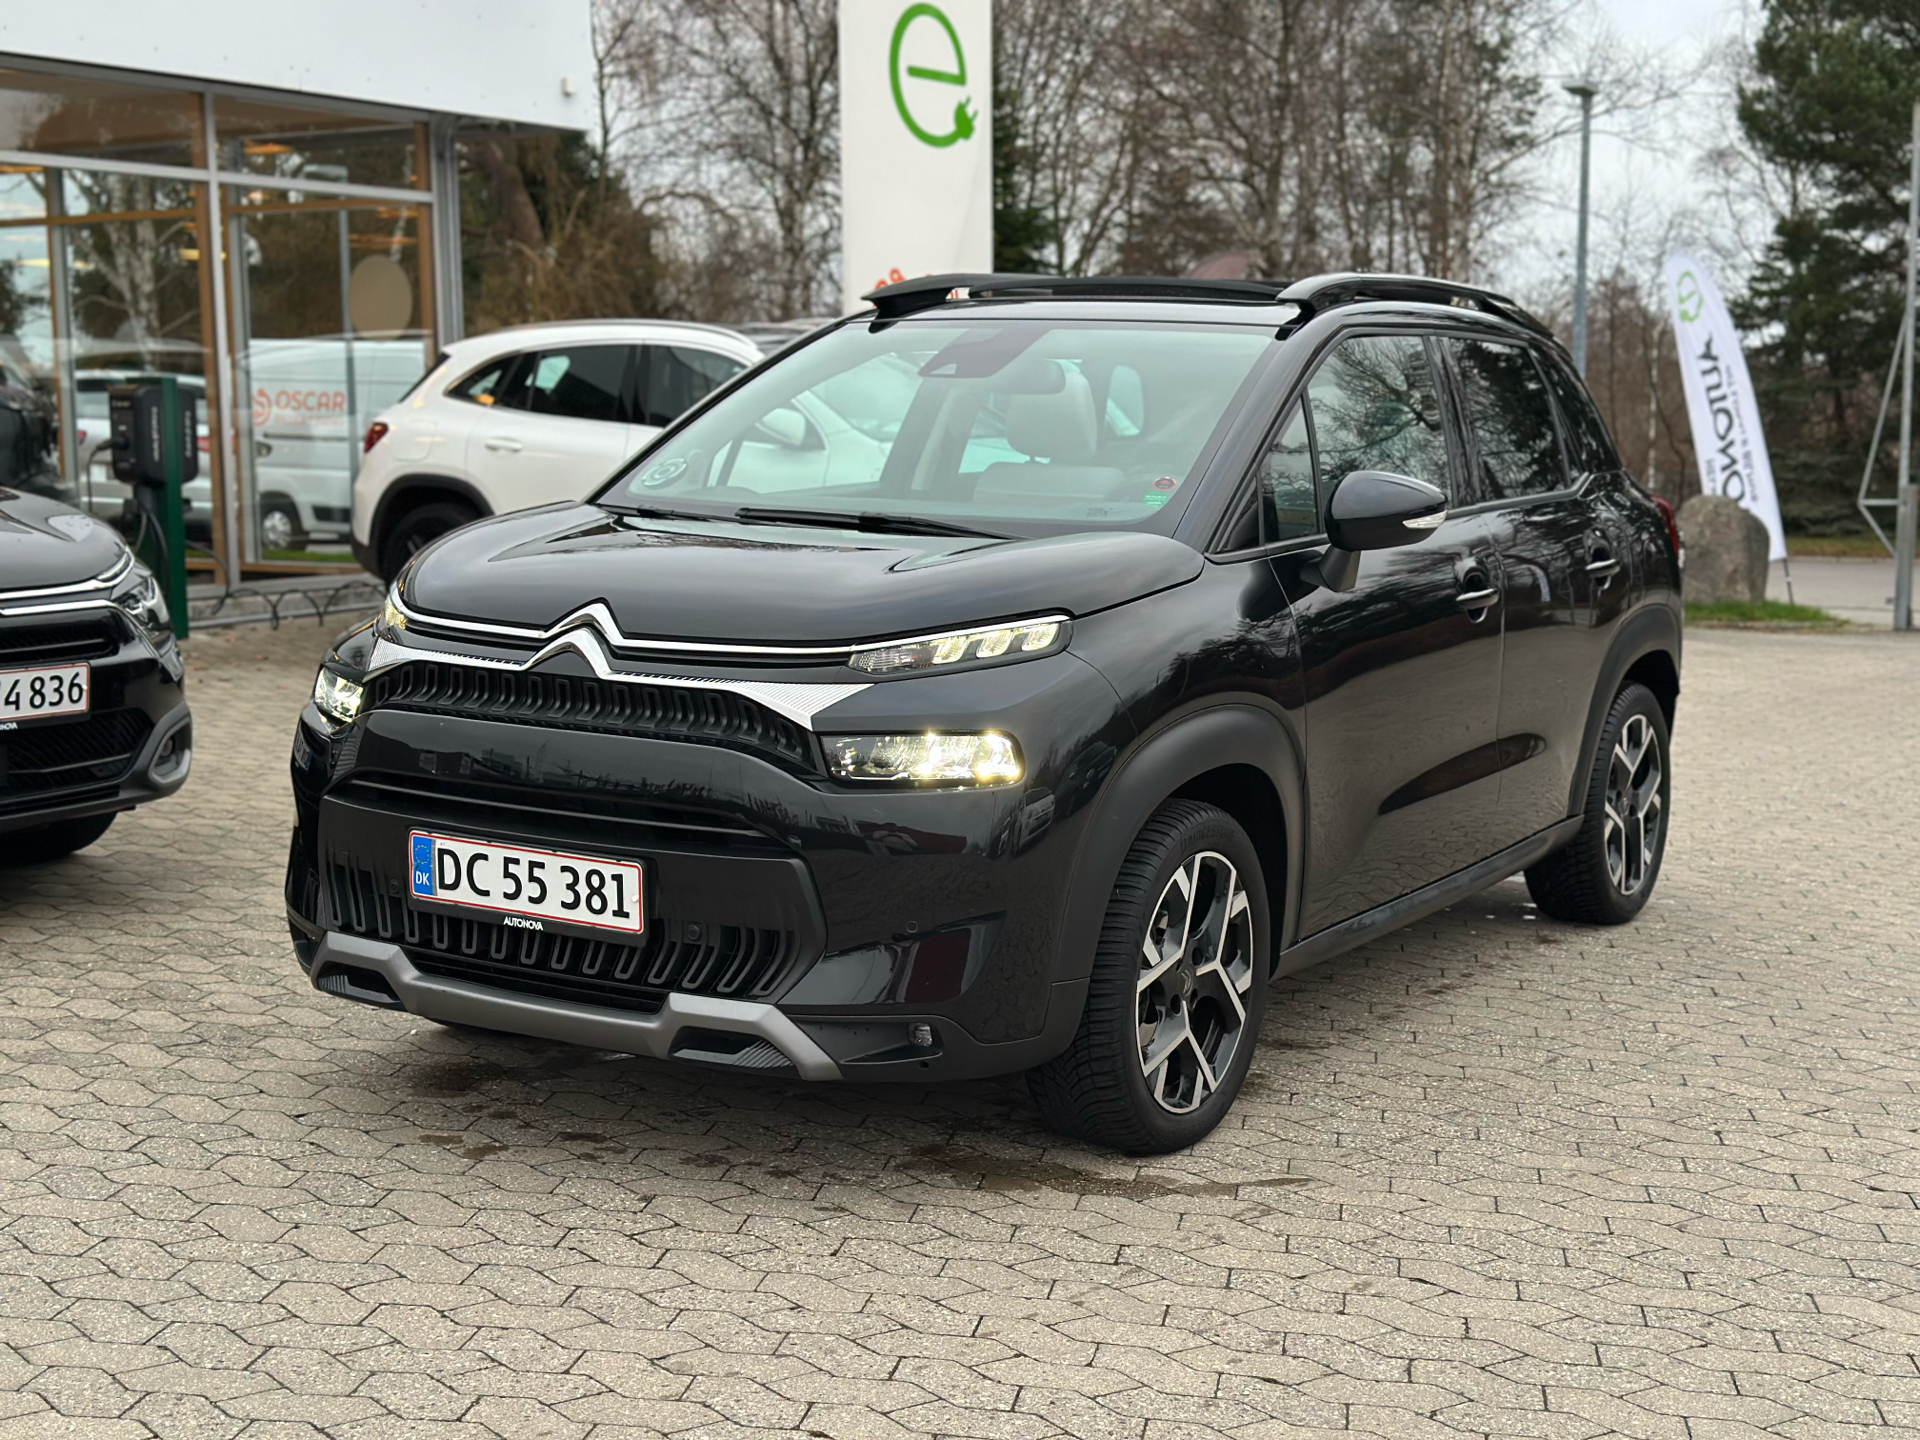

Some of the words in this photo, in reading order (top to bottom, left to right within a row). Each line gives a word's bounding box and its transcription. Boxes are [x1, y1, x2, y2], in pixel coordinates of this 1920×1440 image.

[275, 390, 346, 411] OSCAR
[0, 679, 20, 711] 4
[29, 671, 84, 709] 836
[415, 870, 431, 886] DK
[437, 847, 491, 897] DC
[503, 856, 548, 905] 55
[560, 865, 630, 919] 381
[503, 916, 544, 931] AUTONOVA
